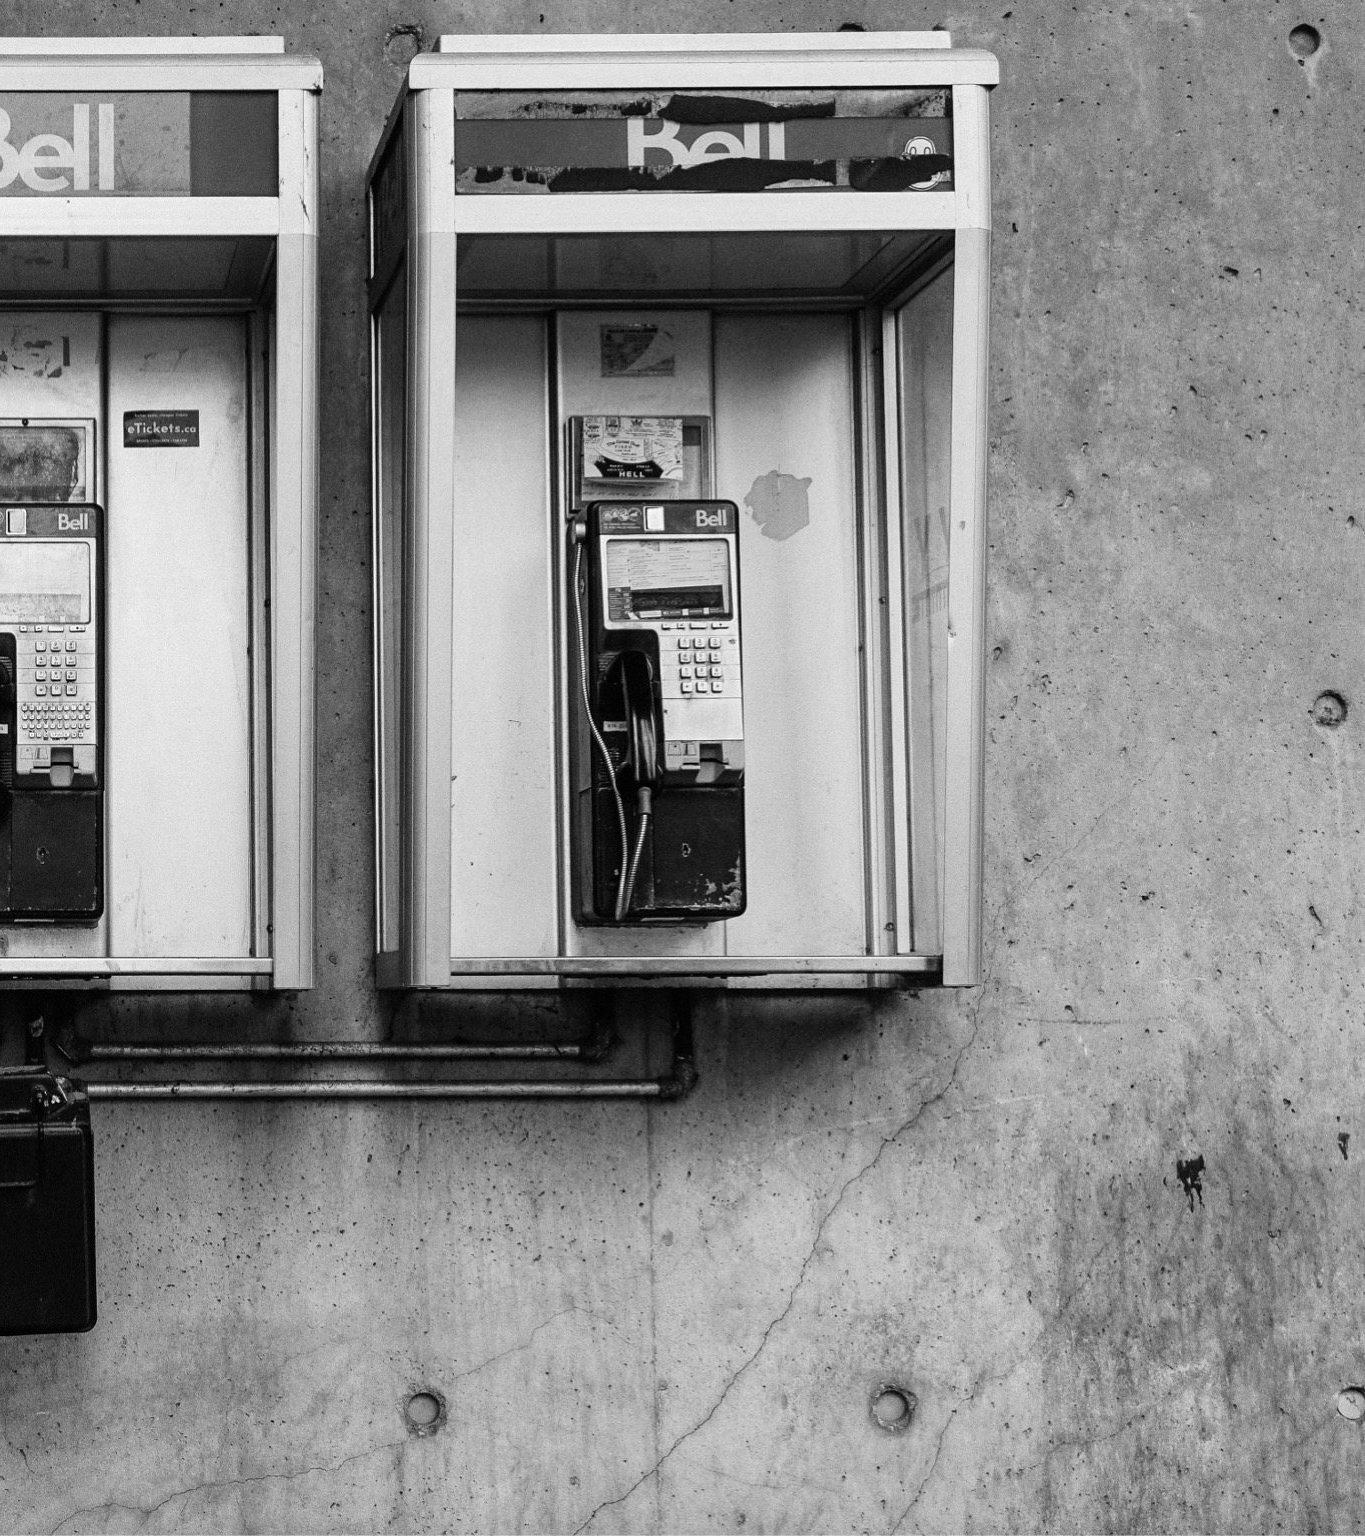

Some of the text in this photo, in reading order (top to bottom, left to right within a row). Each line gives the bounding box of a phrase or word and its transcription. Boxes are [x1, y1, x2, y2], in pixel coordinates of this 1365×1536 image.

[127, 421, 197, 434] eTickets.ca
[58, 513, 89, 531] Bell
[695, 508, 727, 527] Bell
